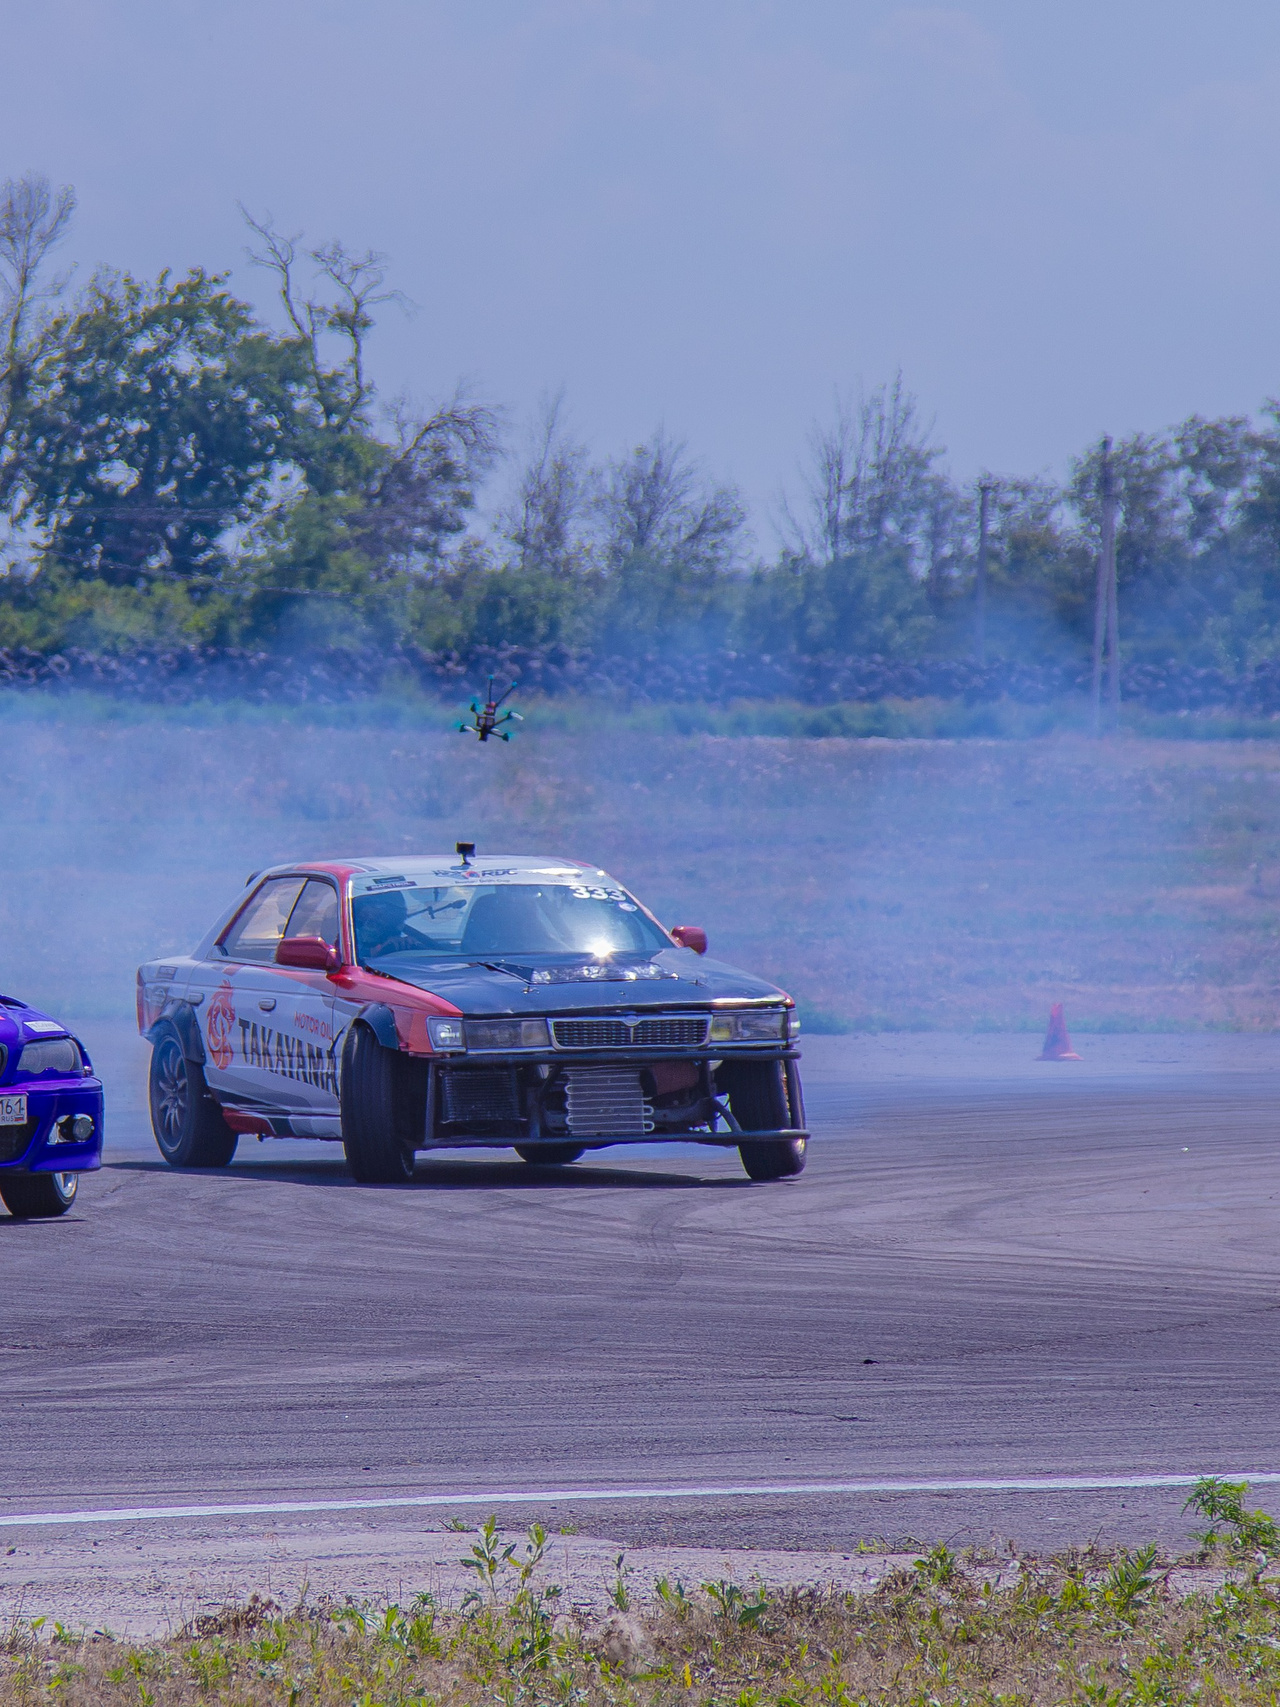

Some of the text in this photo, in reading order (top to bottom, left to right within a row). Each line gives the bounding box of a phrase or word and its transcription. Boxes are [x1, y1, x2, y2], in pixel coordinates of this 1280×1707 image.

[569, 885, 627, 901] 333
[294, 1010, 332, 1040] MOTOR OIL
[238, 1018, 341, 1102] TAKAYAMA
